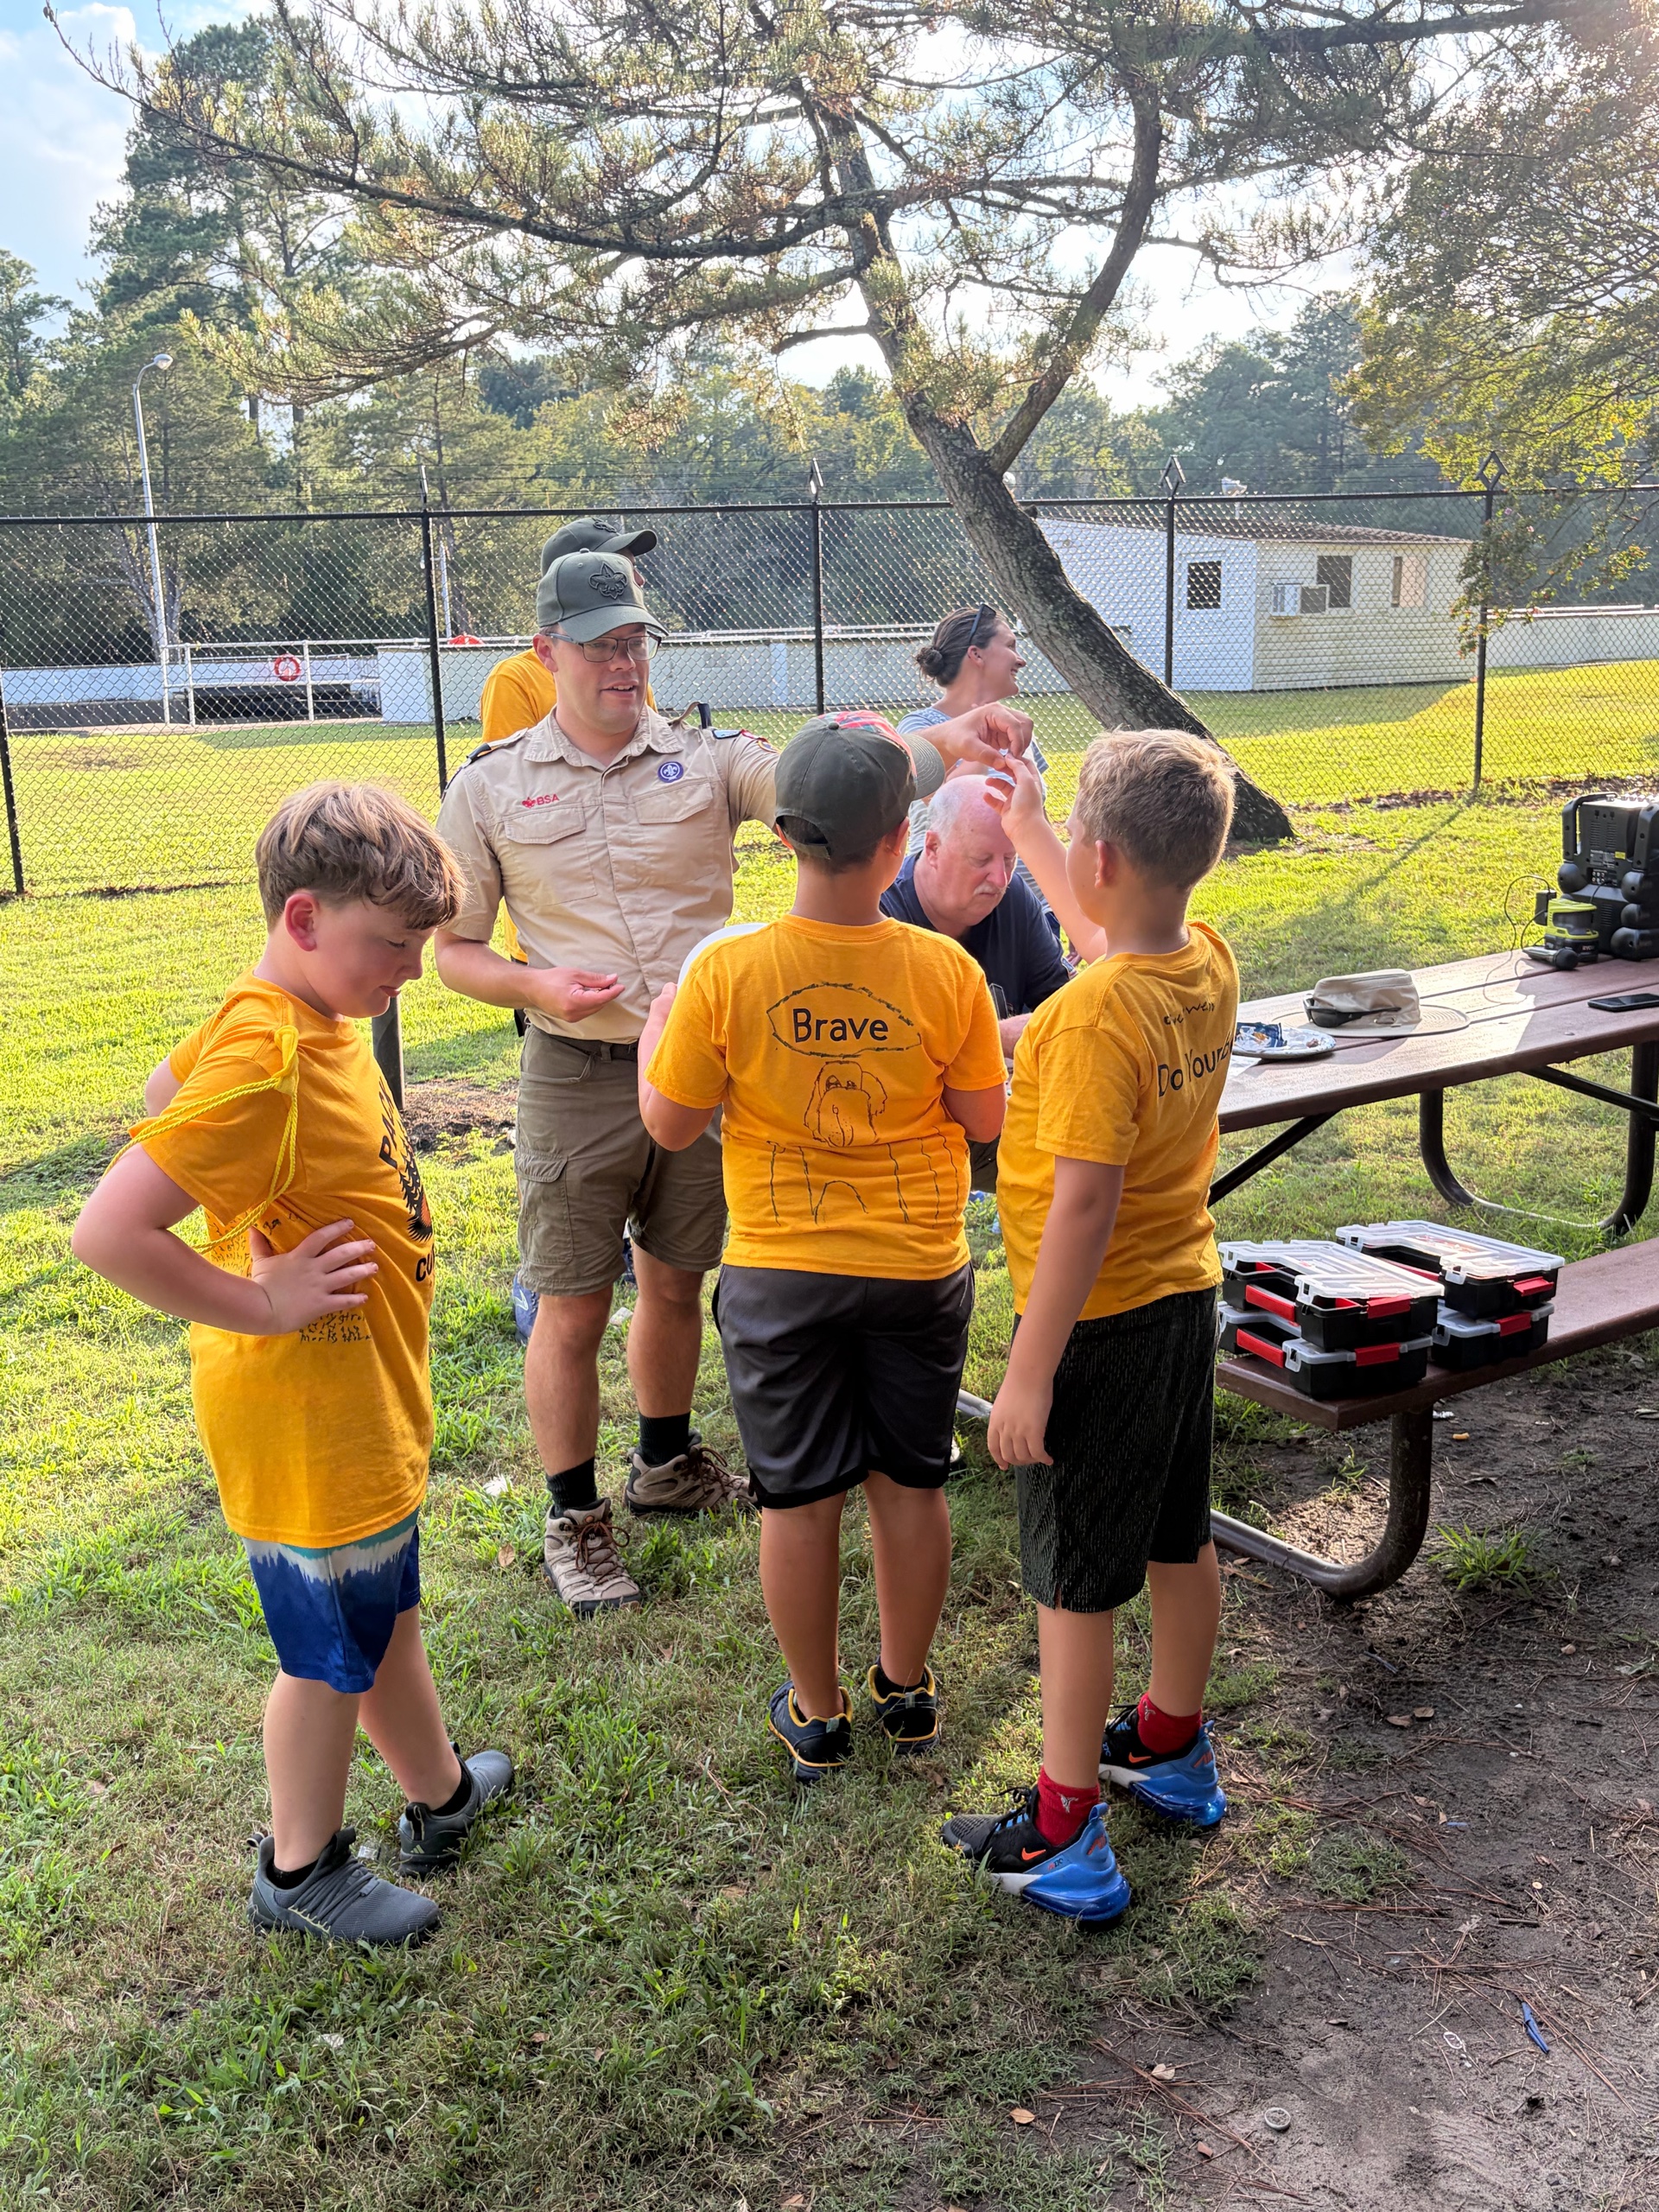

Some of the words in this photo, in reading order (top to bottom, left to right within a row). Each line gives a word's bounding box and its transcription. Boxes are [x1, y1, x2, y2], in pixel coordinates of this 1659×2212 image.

[536, 793, 560, 805] BSA
[792, 1007, 889, 1043] Brave
[1158, 1064, 1184, 1097] Do
[378, 1075, 397, 1169] PACK
